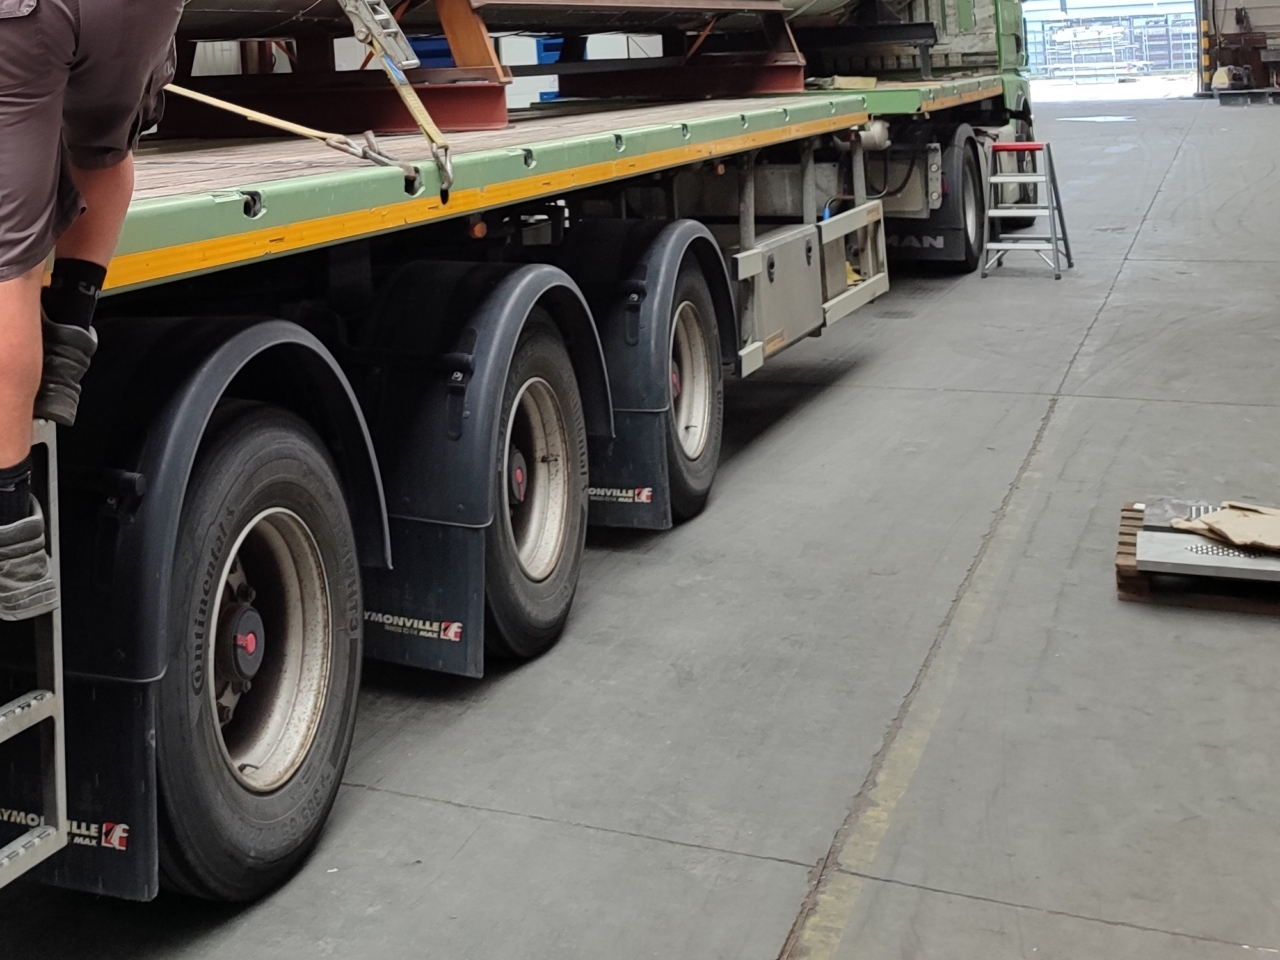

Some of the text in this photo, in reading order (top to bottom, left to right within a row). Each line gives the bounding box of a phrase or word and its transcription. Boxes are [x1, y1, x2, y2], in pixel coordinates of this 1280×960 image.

[588, 487, 634, 497] ONVILLE
[363, 611, 440, 631] YMONVILLE
[419, 630, 439, 639] MAX
[73, 836, 98, 846] MAX
